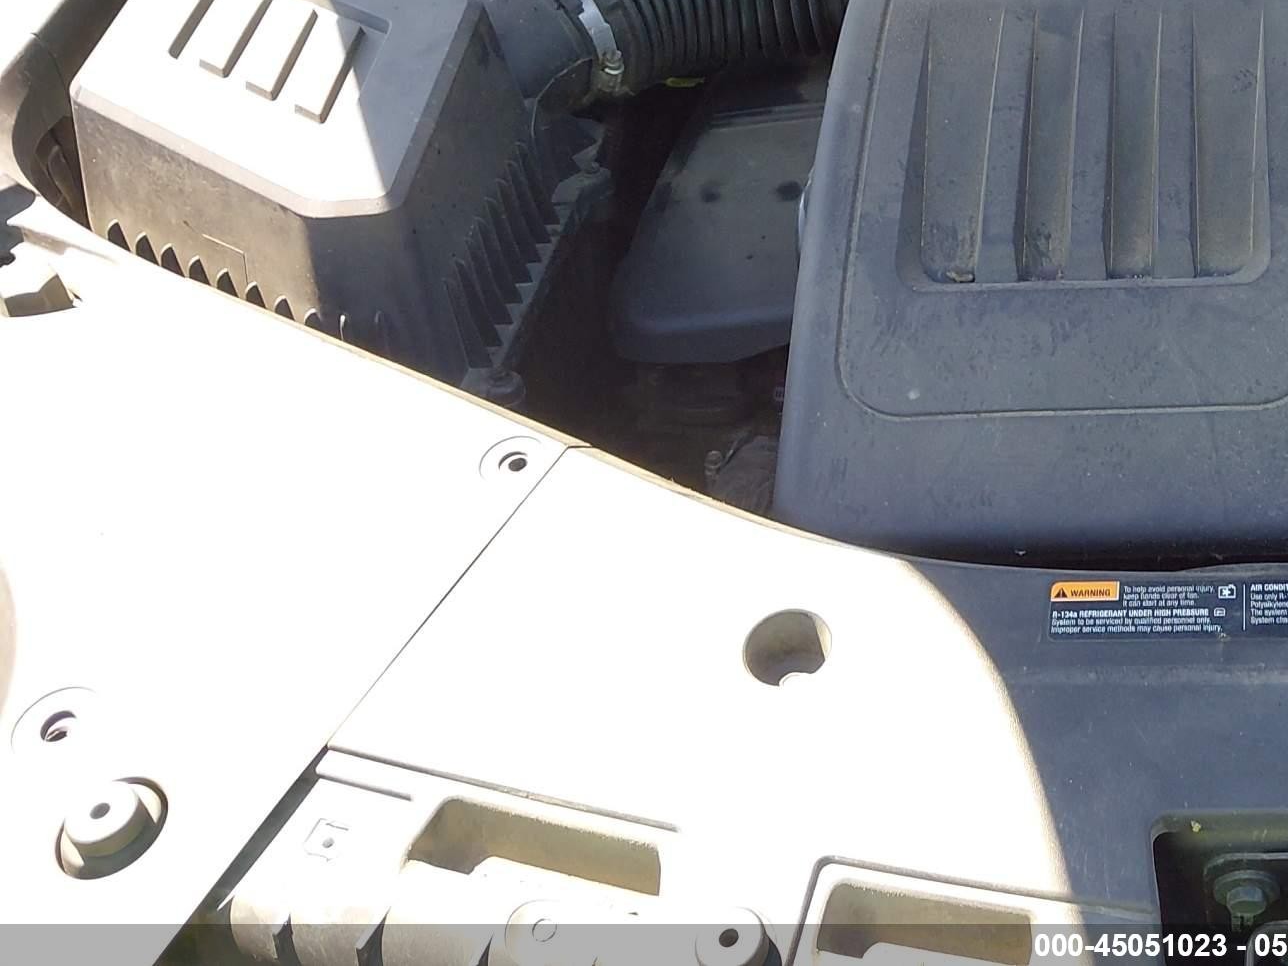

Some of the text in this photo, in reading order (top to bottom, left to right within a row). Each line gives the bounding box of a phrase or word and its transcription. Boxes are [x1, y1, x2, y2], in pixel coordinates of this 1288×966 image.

[1132, 585, 1147, 594] help
[1147, 585, 1166, 593] avoid
[1166, 585, 1195, 594] personal
[1250, 583, 1263, 591] AIR
[1070, 588, 1111, 597] WARNING
[1123, 593, 1139, 601] keep
[1263, 593, 1277, 601] only
[1142, 599, 1157, 607] start
[1166, 599, 1179, 608] any
[1052, 608, 1209, 618] R-134a REFRIGERANT UNDER HIGH PRESSURE
[1250, 608, 1263, 616] The
[1263, 608, 1288, 617] system
[1051, 618, 1076, 627] System
[1077, 618, 1085, 626] to
[1085, 618, 1094, 626] be
[1095, 617, 1123, 625] serviced
[1124, 617, 1132, 627] by
[1133, 617, 1162, 626] qualified
[1250, 616, 1275, 625] System
[1050, 625, 1081, 634] Improper
[1081, 625, 1106, 633] service
[1106, 625, 1136, 633] methods
[1136, 625, 1152, 634] may
[1152, 625, 1172, 633] cause
[1173, 624, 1202, 633] personal
